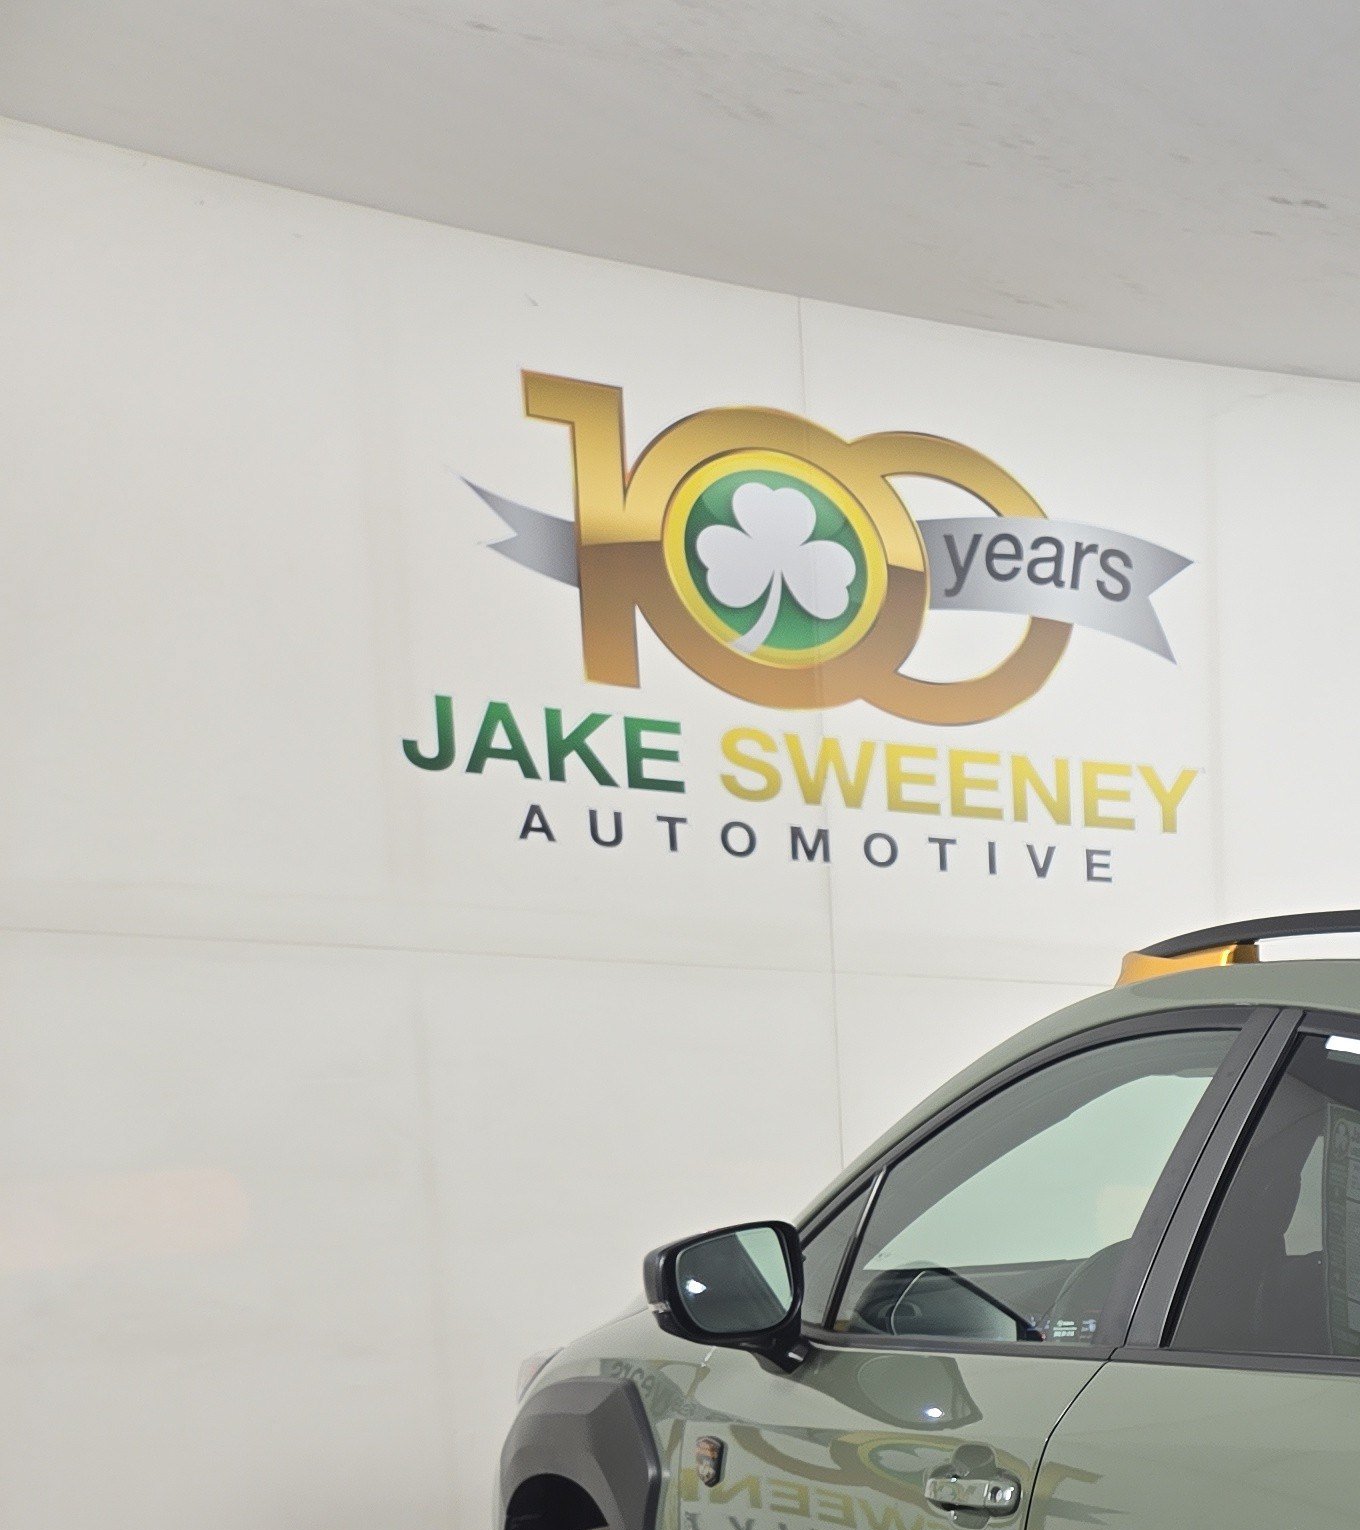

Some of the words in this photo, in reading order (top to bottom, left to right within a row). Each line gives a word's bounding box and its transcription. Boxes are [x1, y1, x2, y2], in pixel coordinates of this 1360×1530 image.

[942, 530, 1134, 603] years
[402, 693, 687, 796] JAKE
[720, 726, 1202, 835] SWEENEY
[518, 804, 1114, 884] AUTOMOTIVE
